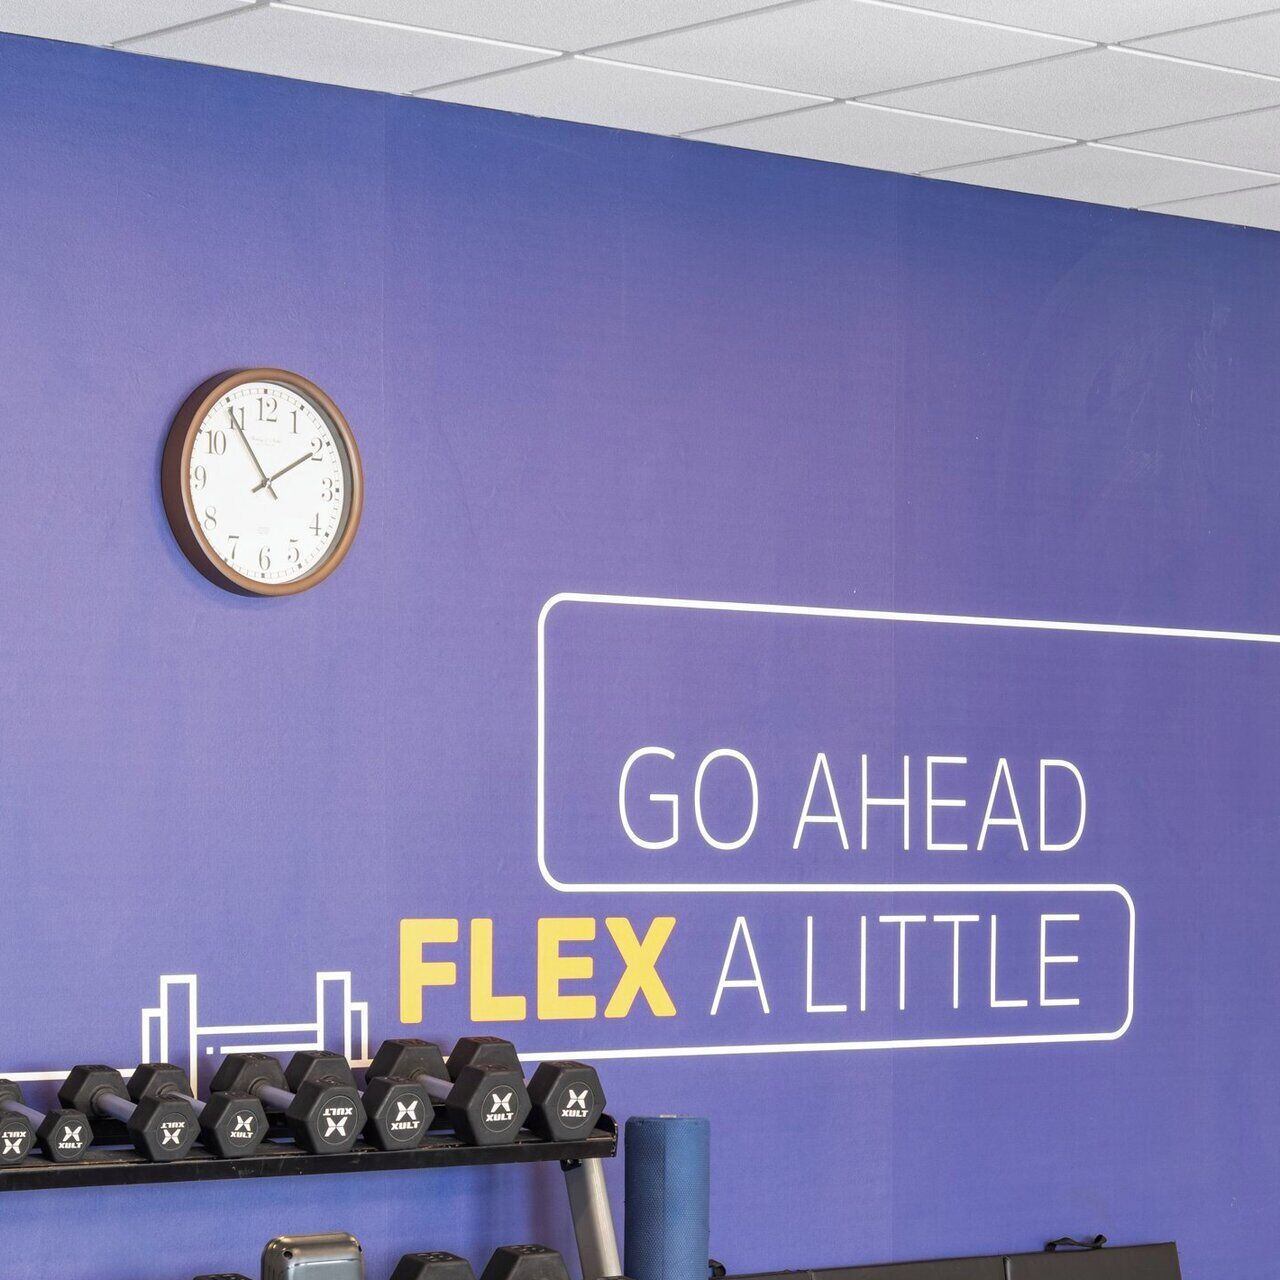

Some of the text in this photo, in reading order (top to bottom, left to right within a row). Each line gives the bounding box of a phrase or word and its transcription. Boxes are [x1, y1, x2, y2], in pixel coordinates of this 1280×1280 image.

[257, 397, 277, 422] 12
[289, 411, 299, 434] 1
[206, 430, 226, 454] 10
[310, 438, 323, 461] 2
[194, 466, 207, 490] 9
[322, 478, 333, 501] 3
[204, 506, 217, 530] 8
[309, 513, 321, 536] 4
[229, 536, 239, 559] 7
[258, 545, 271, 570] 6
[288, 540, 299, 562] 5
[619, 747, 1085, 851] GO AHEAD
[401, 914, 1081, 1022] FLEX A LITTLE
[323, 1108, 353, 1116] XULT
[486, 1113, 514, 1121] XULT
[391, 1121, 420, 1130] XULT
